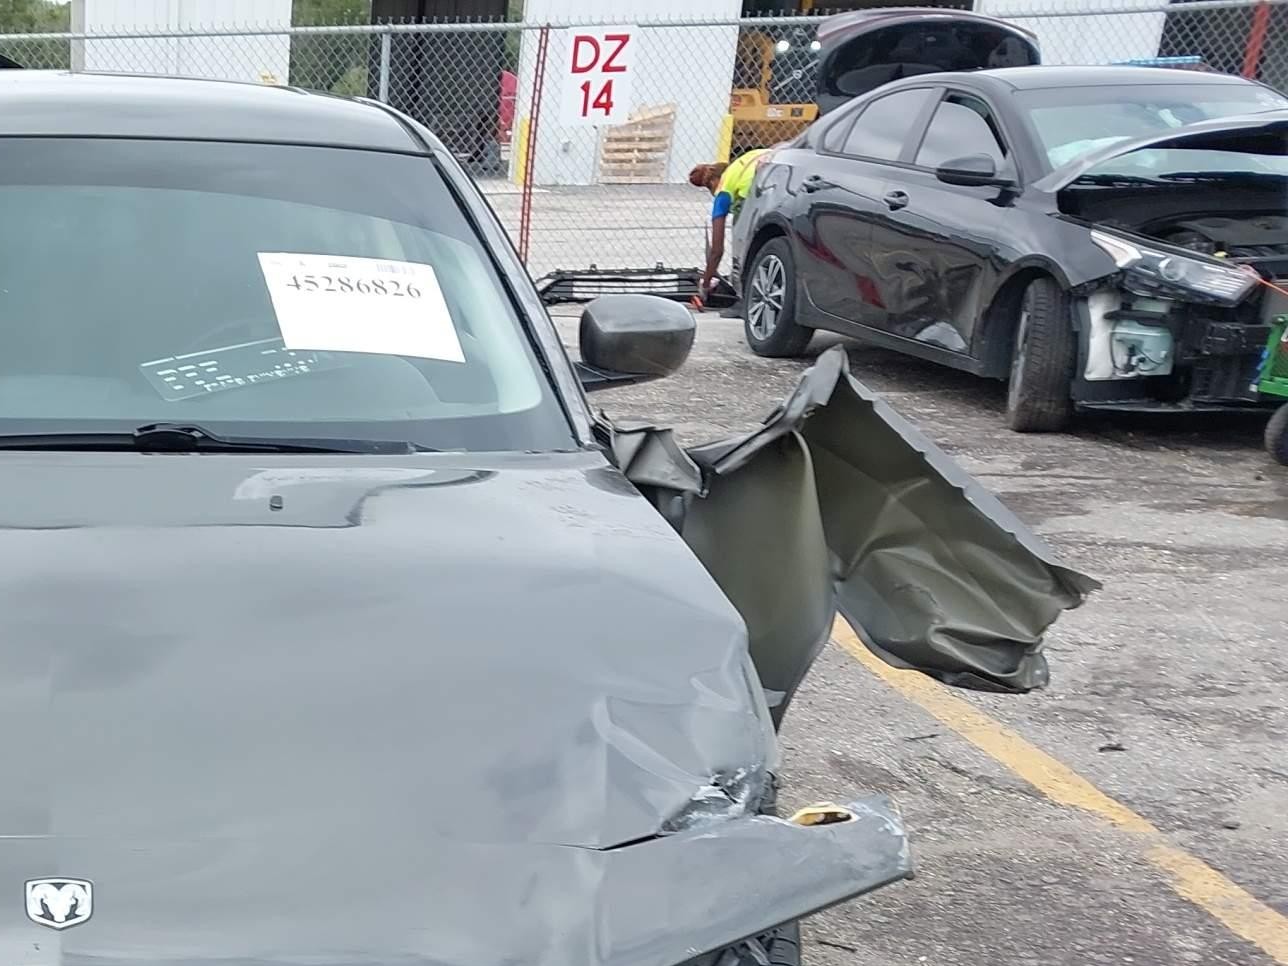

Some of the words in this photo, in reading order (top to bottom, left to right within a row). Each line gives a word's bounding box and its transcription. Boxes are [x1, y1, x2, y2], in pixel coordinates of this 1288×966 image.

[571, 34, 630, 73] DZ
[580, 80, 613, 117] 14
[286, 274, 422, 299] 45286826
